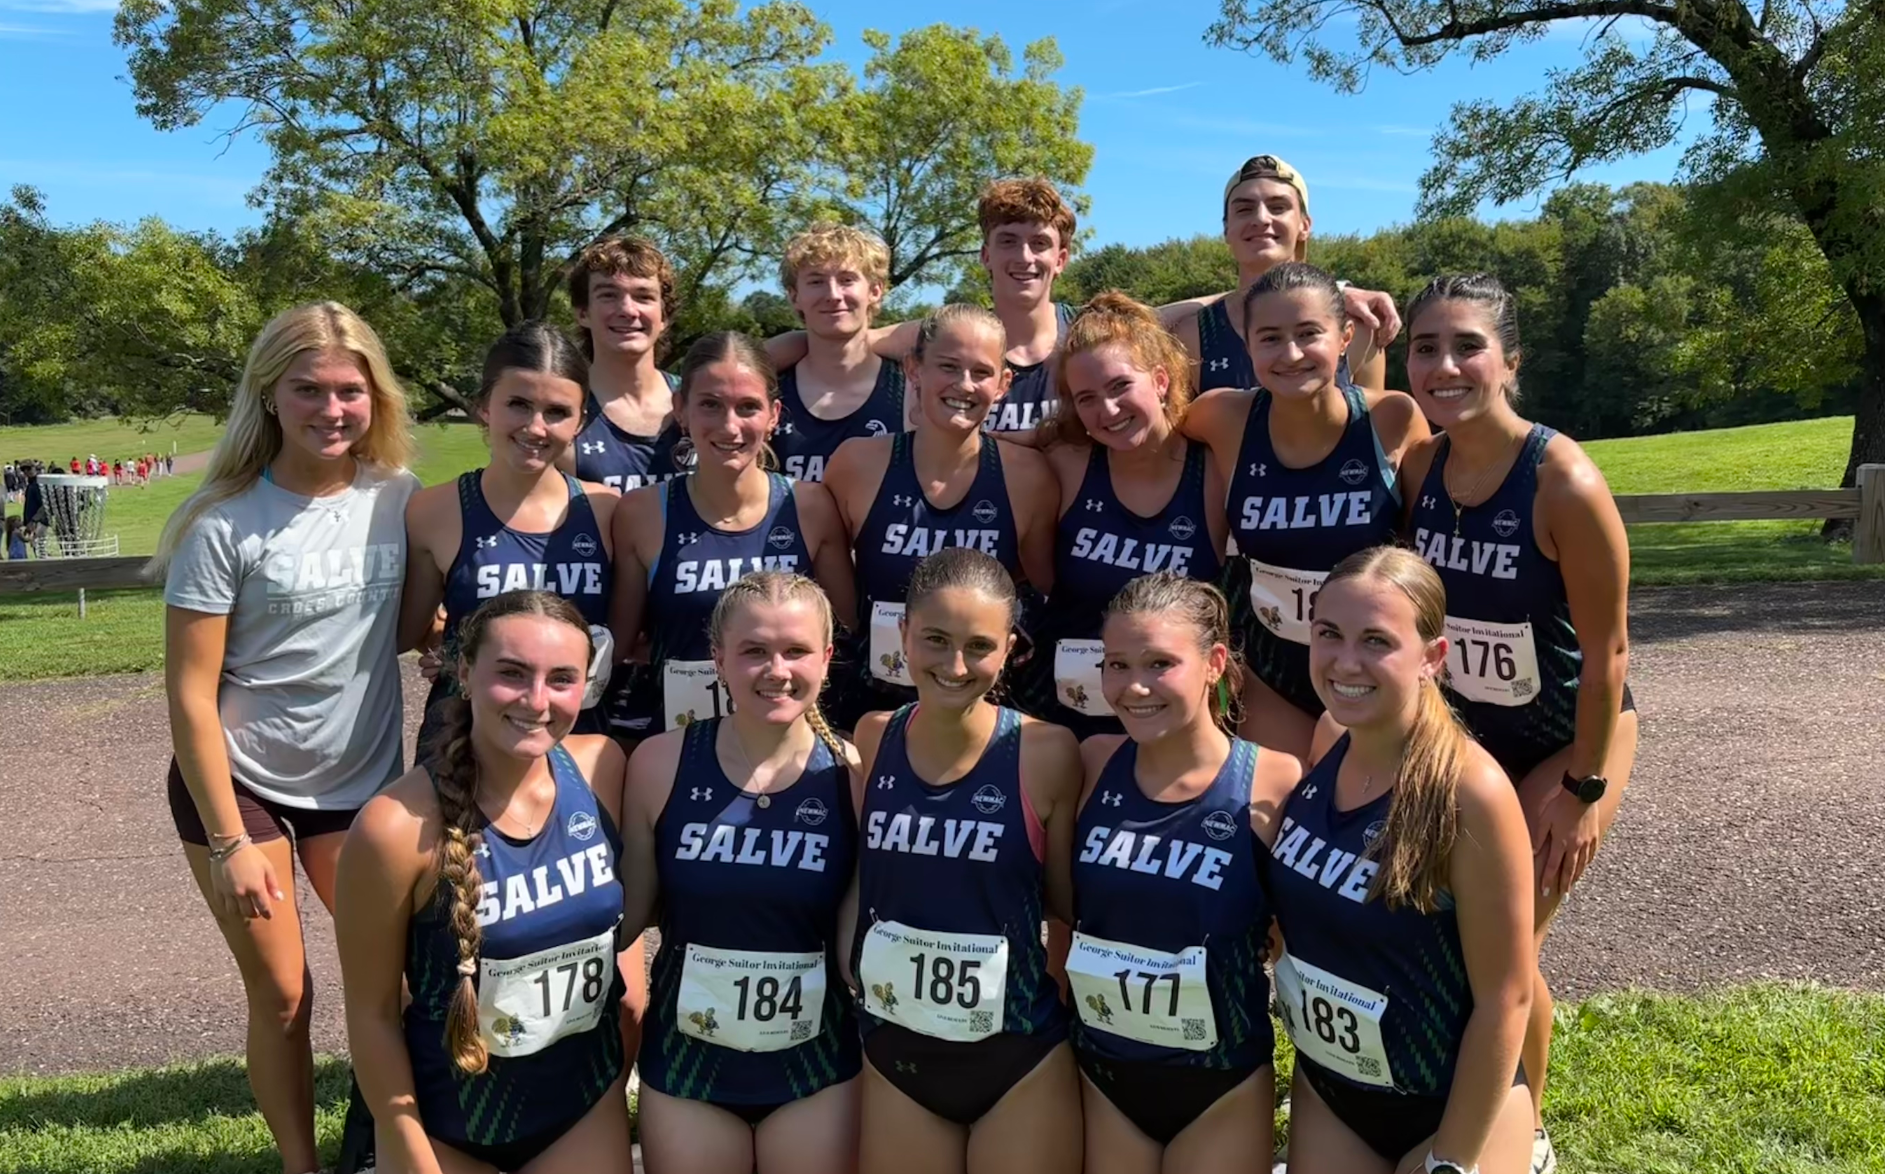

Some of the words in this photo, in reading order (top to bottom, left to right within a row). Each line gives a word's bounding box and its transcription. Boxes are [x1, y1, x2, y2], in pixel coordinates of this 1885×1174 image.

[1240, 490, 1372, 530] SALVE
[881, 523, 1000, 558] SALVE
[1070, 527, 1194, 578] SALVE
[1415, 527, 1521, 580] SALVE
[267, 542, 400, 594] SALVE
[476, 562, 602, 599] SALVE
[1256, 566, 1285, 579] George
[268, 598, 326, 615] CROSS
[1061, 646, 1089, 655] George
[1472, 627, 1524, 638] Invitational
[669, 666, 697, 677] George
[698, 668, 718, 676] Suit
[1455, 638, 1516, 681] 176
[866, 811, 1005, 862] SALVE
[1203, 818, 1237, 834] NEWMAC
[675, 822, 829, 872] SALVE
[1079, 826, 1233, 891] SALVE
[475, 843, 614, 927] SALVE
[873, 925, 902, 943] George
[902, 935, 935, 949] Suitor
[936, 940, 998, 954] Invitational
[1079, 941, 1113, 958] George
[1113, 950, 1146, 965] Suitor
[488, 966, 526, 978] George
[526, 956, 560, 968] Suitor
[692, 952, 727, 968] George
[728, 958, 761, 970] Suitor
[763, 958, 818, 970] Invitational
[910, 952, 981, 1009] 185
[534, 957, 604, 1017] 178
[733, 975, 804, 1021] 184
[1113, 967, 1180, 1016] 177
[1315, 979, 1377, 1011] Invitational
[1301, 988, 1361, 1054] 183
